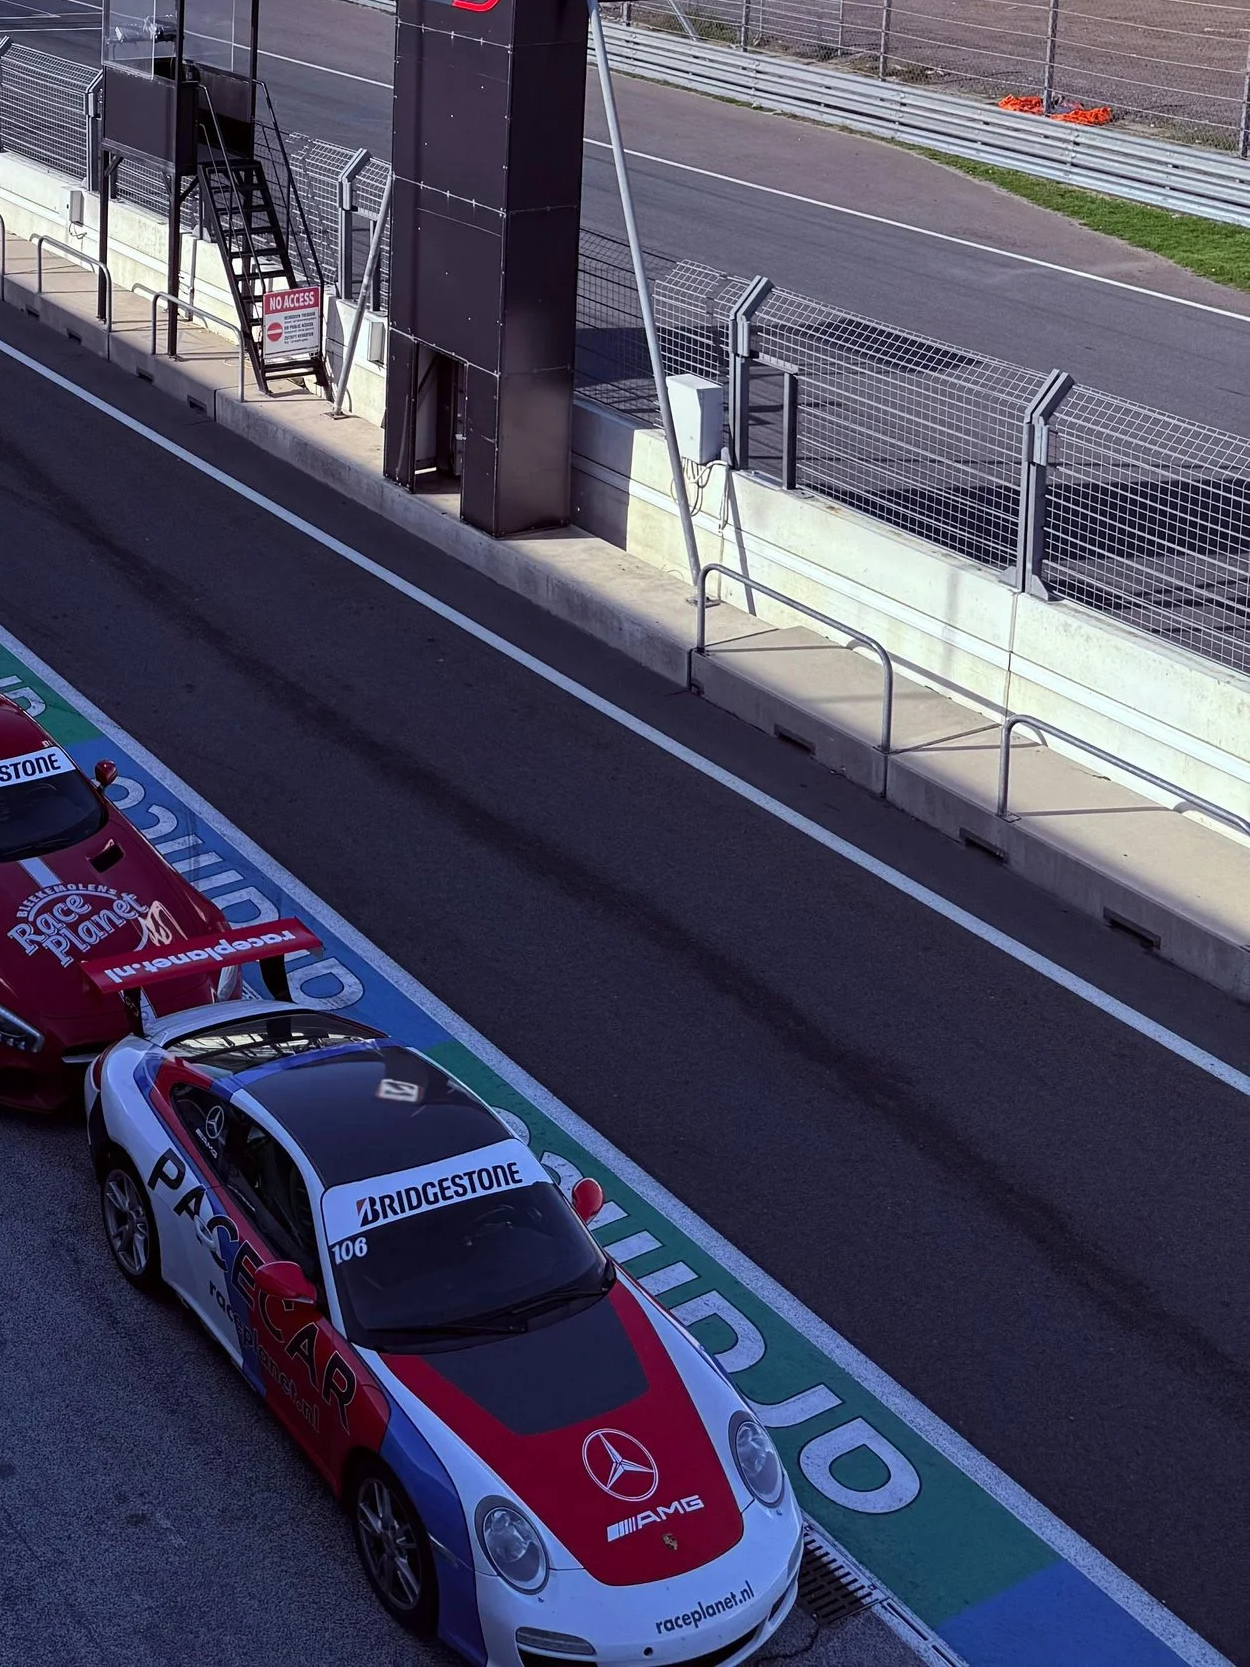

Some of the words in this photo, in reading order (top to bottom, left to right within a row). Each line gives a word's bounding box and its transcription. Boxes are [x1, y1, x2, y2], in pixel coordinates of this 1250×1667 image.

[269, 296, 283, 311] NO
[283, 291, 315, 309] ACCESS
[6, 893, 93, 956] Race
[15, 882, 119, 919] BLEEKEMOLENS
[93, 774, 364, 1012] aamco
[40, 891, 150, 969] Planet
[104, 929, 297, 984] raceplanet.nl
[355, 1162, 523, 1228] BRIDGESTONE
[330, 1237, 368, 1266] 106
[147, 1147, 358, 1437] PACECAR
[493, 1106, 922, 1515] aram
[208, 1282, 320, 1434] raceplanet.nl
[637, 1494, 705, 1530] AMG
[655, 1580, 755, 1635] raceplanet.nl
